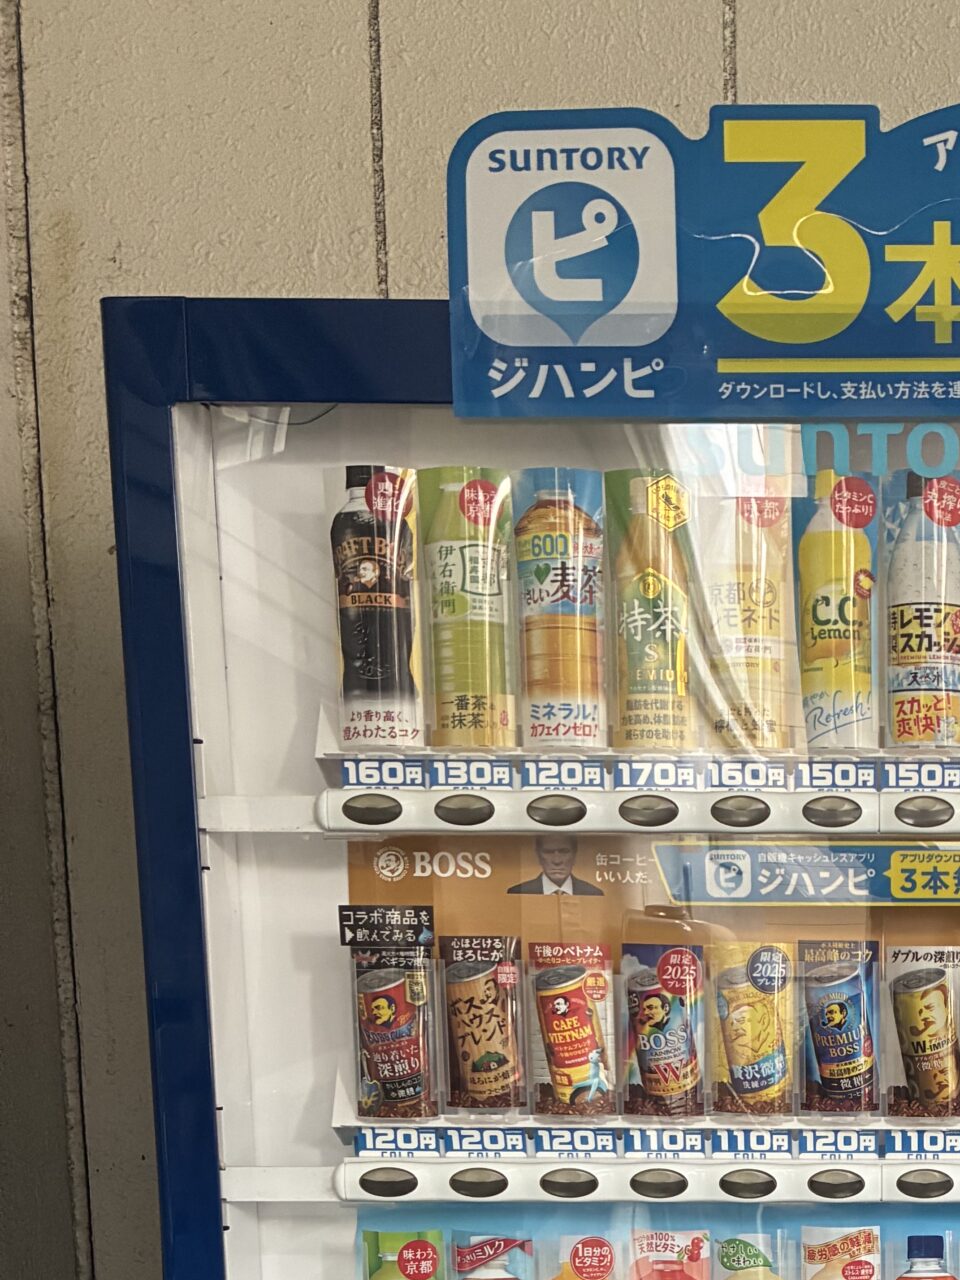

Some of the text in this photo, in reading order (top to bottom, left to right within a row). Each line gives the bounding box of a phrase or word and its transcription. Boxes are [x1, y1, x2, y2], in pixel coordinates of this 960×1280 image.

[488, 146, 650, 173] SUNTORY
[531, 198, 618, 301] ピ
[487, 358, 664, 398] ジハンピ
[531, 534, 568, 557] 600
[438, 545, 456, 614] 伊右衛門
[351, 595, 392, 605] BLACK
[810, 625, 860, 642] Lemon
[350, 710, 409, 722] より香り高く、
[530, 703, 598, 722] ミネラル!
[530, 723, 598, 738] カフェインゼロ!
[343, 761, 422, 784] 160円
[433, 761, 509, 785] 130円
[524, 762, 600, 785] 120円
[617, 762, 694, 786] 170円
[707, 763, 784, 786] 160円
[798, 763, 874, 787] 150円
[884, 763, 960, 787] 150円
[413, 852, 492, 878] BOSS
[758, 868, 876, 896] ジハンピ
[342, 908, 430, 926] コラボ商品を
[357, 926, 416, 942] 飲んでみる
[453, 950, 503, 962] ほろにが
[534, 945, 604, 957] 午後のベトナム
[662, 965, 697, 980] 2025
[552, 1016, 580, 1031] CAFE
[638, 1025, 687, 1051] BOSS
[829, 1043, 860, 1058] BOSS
[361, 1129, 437, 1150] 120円
[448, 1130, 524, 1150] 120円
[537, 1130, 613, 1150] 120円
[626, 1130, 702, 1151] 110円
[713, 1130, 788, 1151] 110円
[801, 1130, 876, 1151] 120円
[403, 1248, 437, 1260] 味わう、
[575, 1244, 610, 1257] 1日分の
[575, 1255, 611, 1267] ビタミン!
[404, 1260, 433, 1273] 京都
